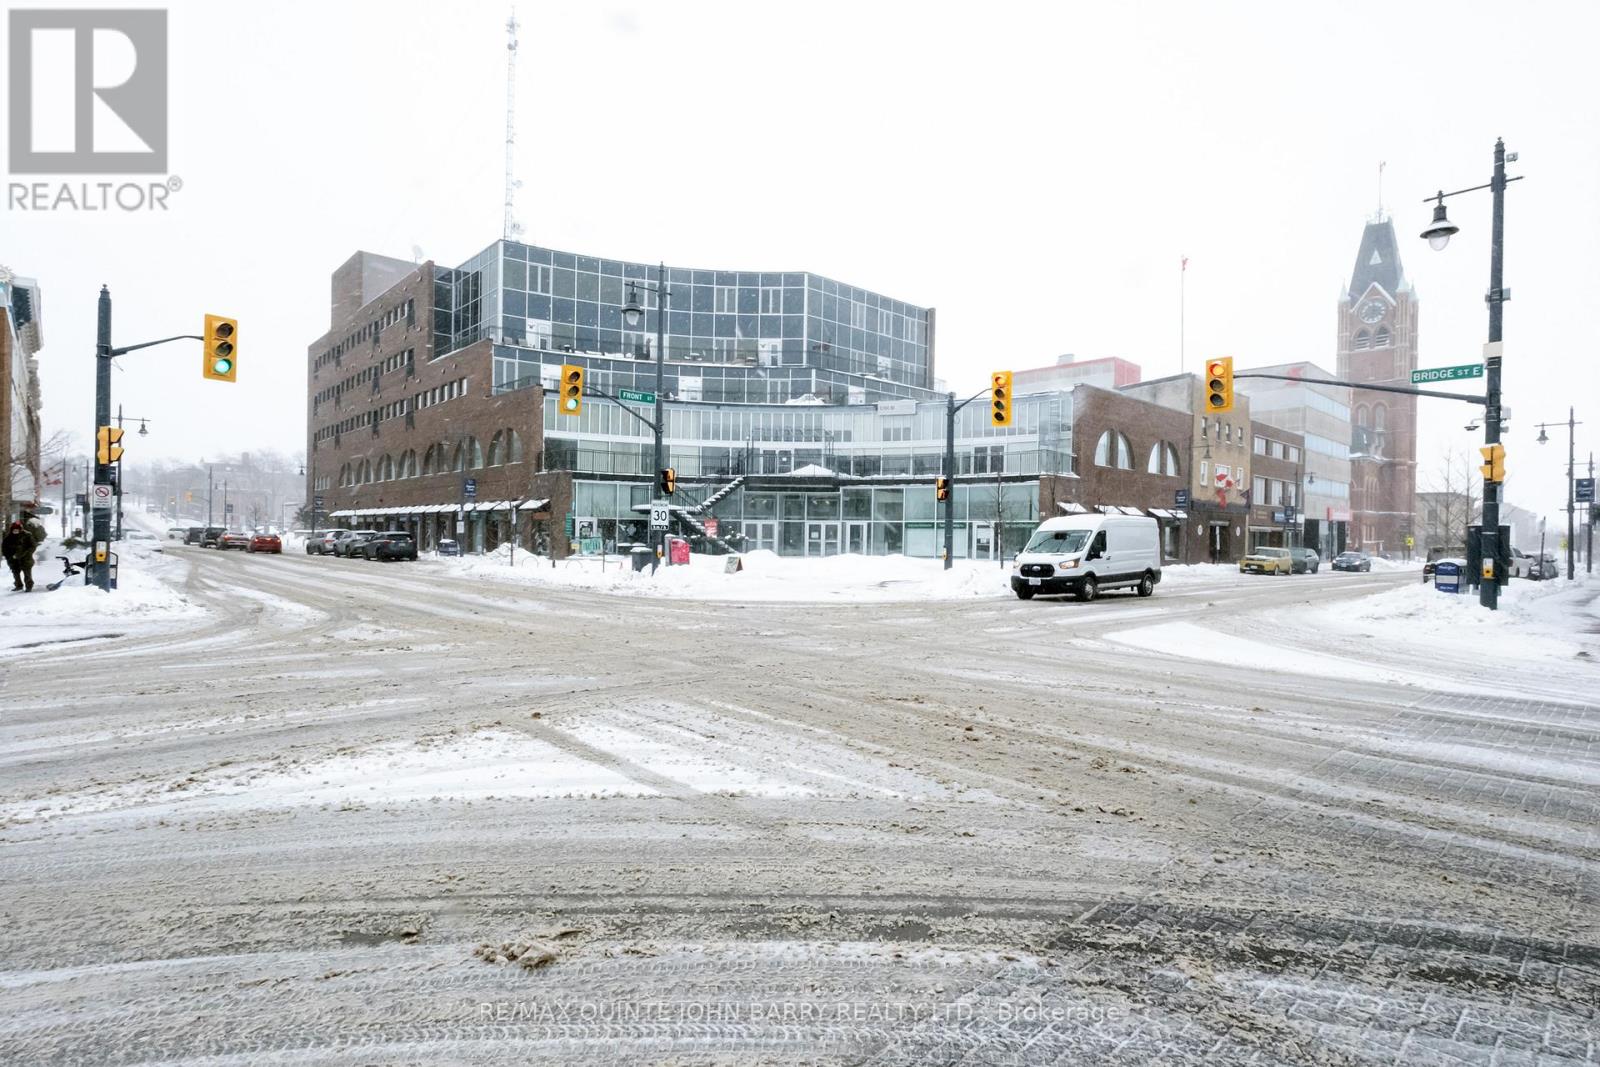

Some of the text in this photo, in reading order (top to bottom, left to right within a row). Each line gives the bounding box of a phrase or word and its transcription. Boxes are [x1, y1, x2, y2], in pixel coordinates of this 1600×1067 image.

[1413, 369, 1454, 382] BRIDGE
[1473, 366, 1481, 376] E
[622, 391, 643, 401] FRONT
[653, 510, 667, 522] 30
